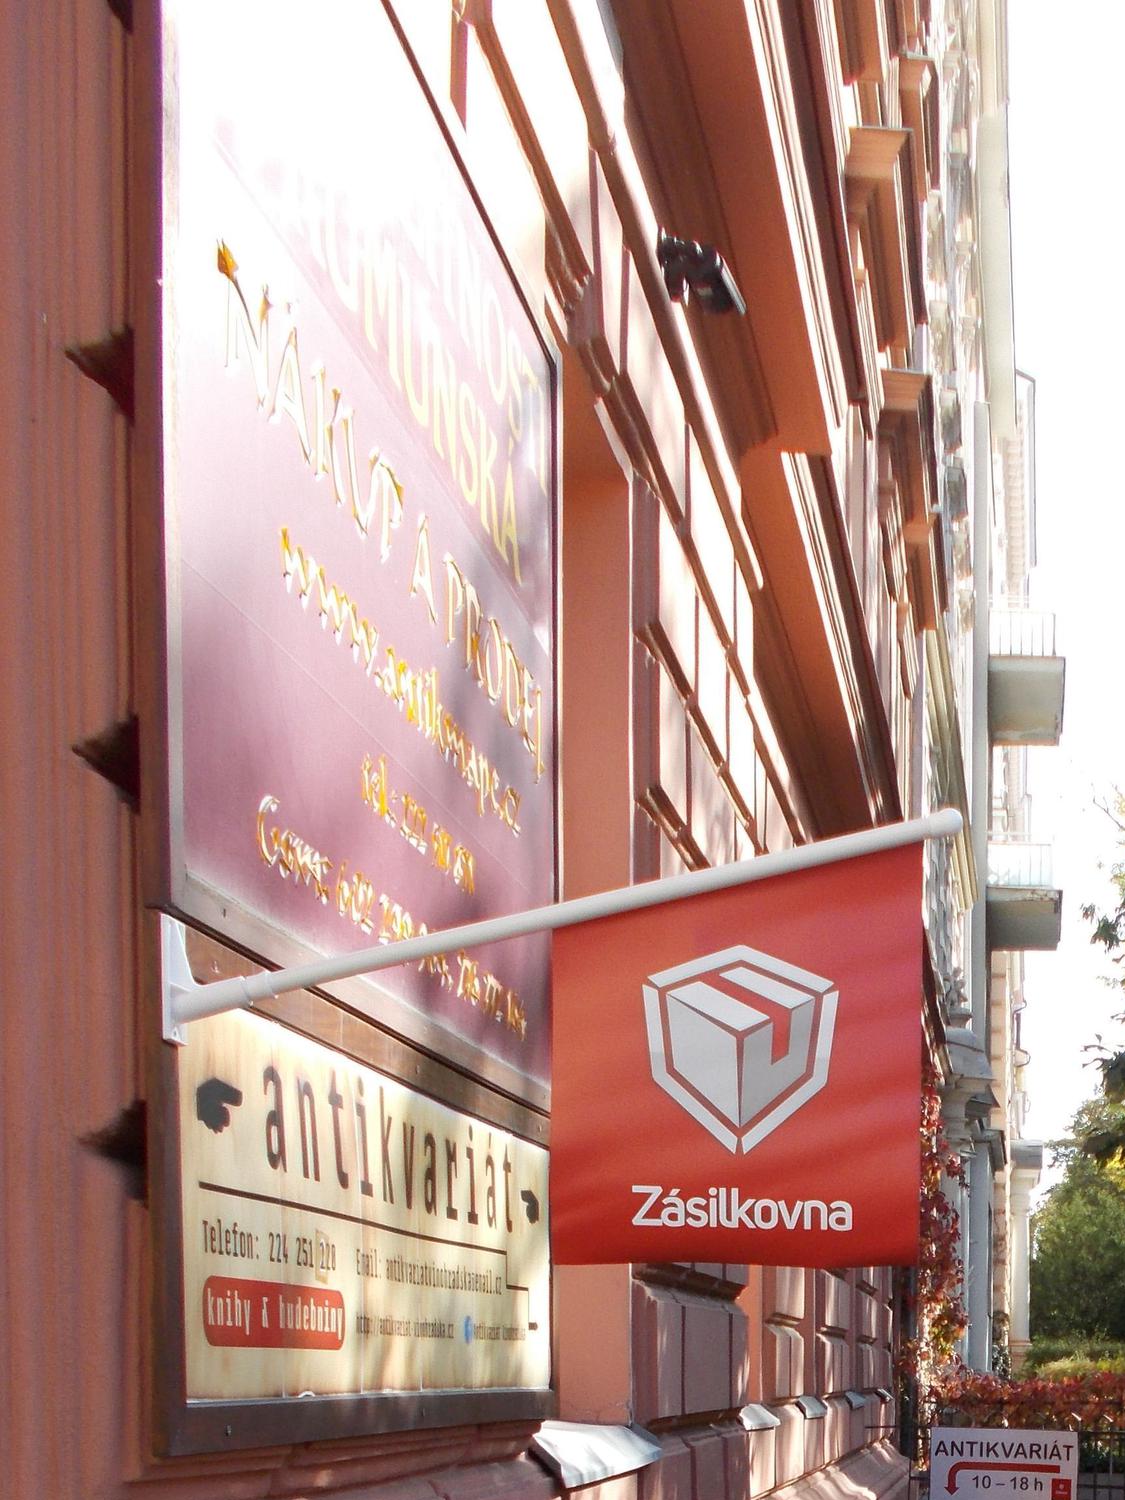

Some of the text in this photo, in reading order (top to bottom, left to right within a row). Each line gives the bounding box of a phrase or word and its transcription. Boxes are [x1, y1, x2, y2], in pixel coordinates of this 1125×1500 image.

[410, 512, 438, 626] A
[443, 552, 544, 784] PRODEJ
[263, 1065, 513, 1233] antikvariát
[632, 1185, 852, 1231] Zásilkovna
[202, 1219, 260, 1260] Telefon:
[268, 1232, 289, 1264] 224
[296, 1237, 314, 1268] 251
[207, 1287, 250, 1335] knihy
[279, 1294, 343, 1341] hudebniny
[934, 1440, 1074, 1461] ANTIKVARIÁT
[972, 1475, 991, 1489] 10
[1010, 1476, 1028, 1490] 18
[1034, 1478, 1043, 1491] h
